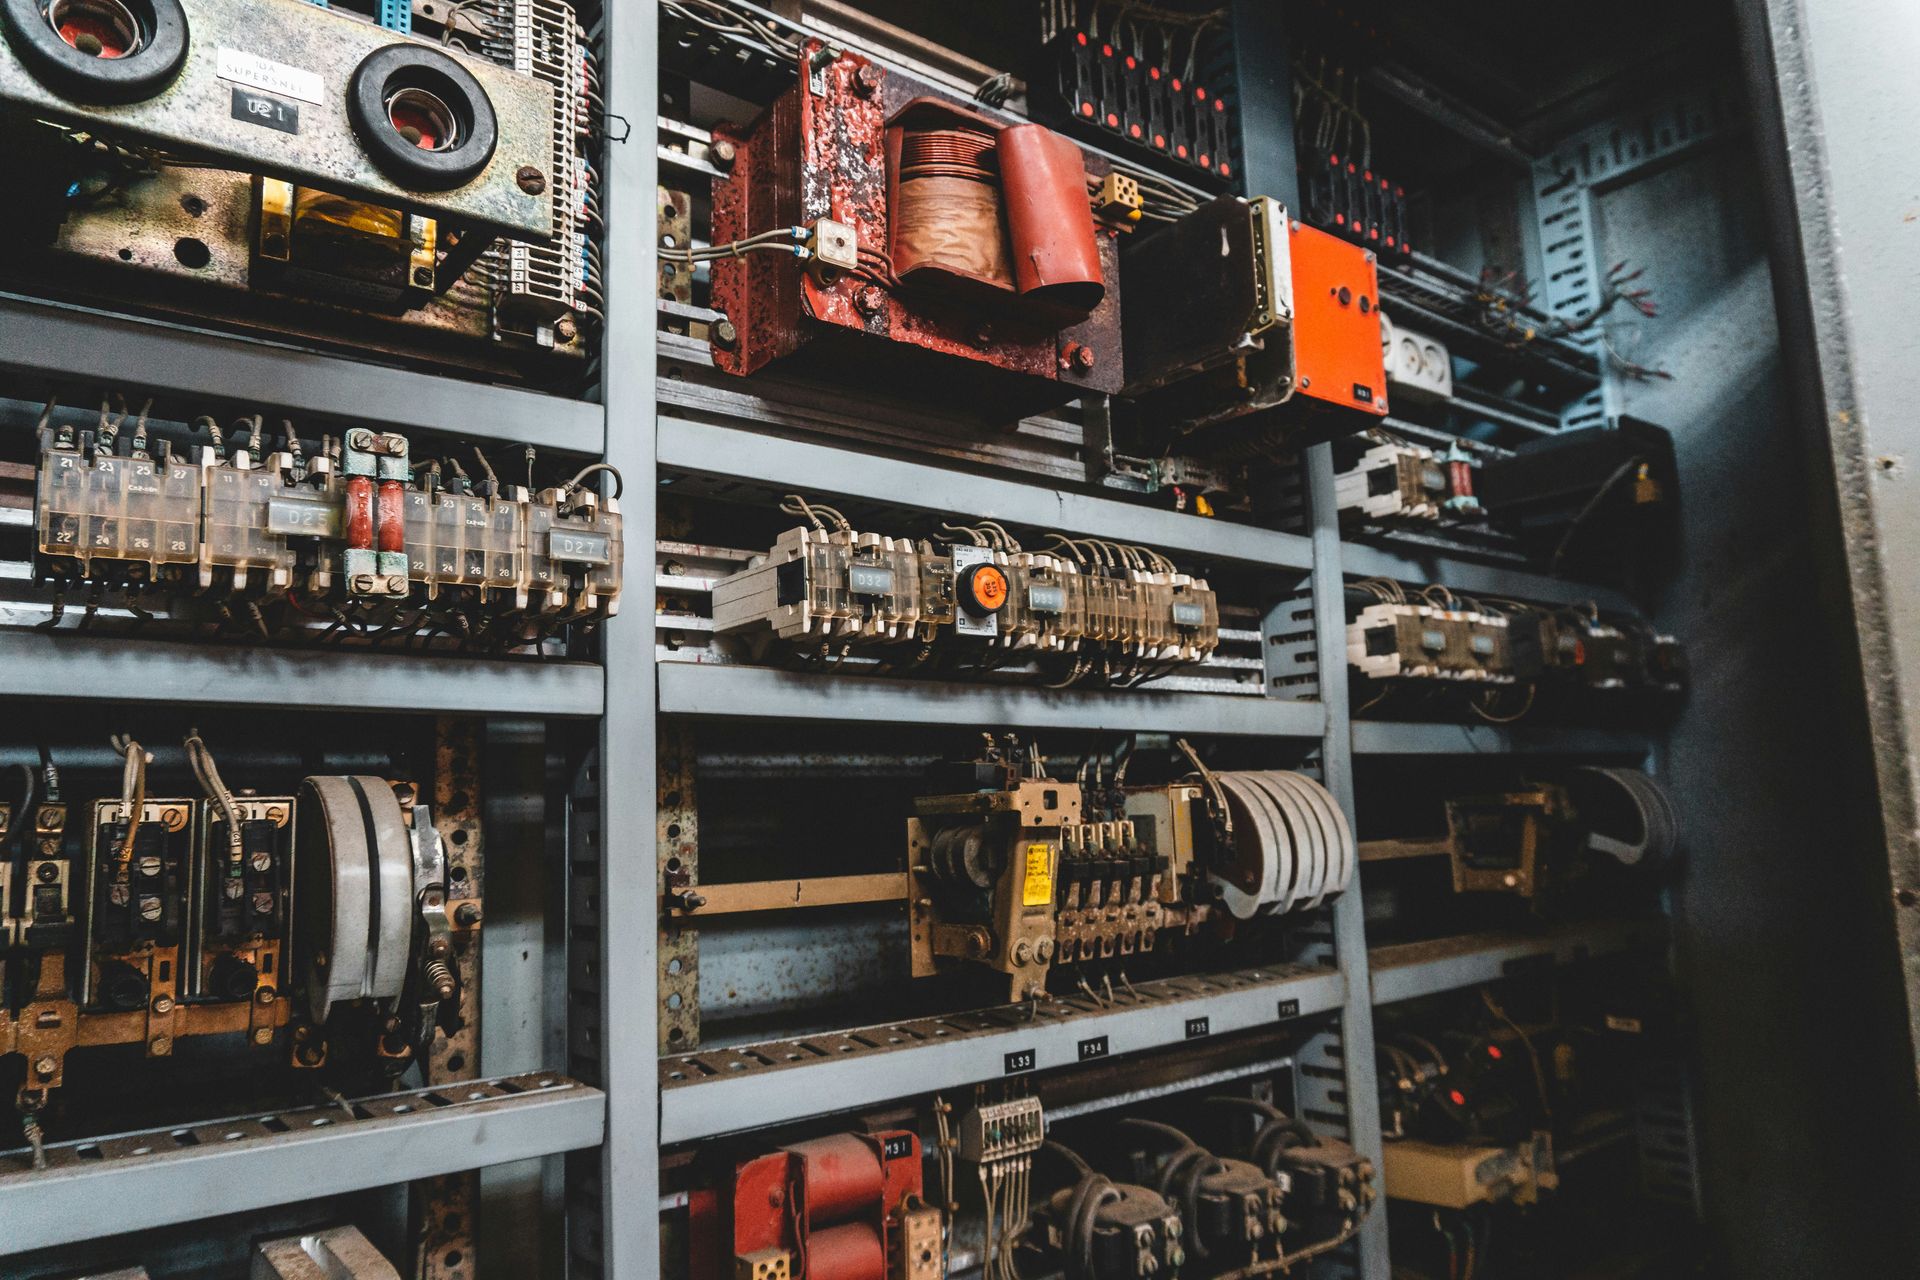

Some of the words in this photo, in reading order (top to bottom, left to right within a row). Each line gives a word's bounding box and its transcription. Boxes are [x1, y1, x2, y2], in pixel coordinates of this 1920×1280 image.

[577, 302, 585, 310] 27
[61, 457, 73, 468] 21
[99, 462, 114, 472] 23
[136, 465, 151, 476] 25
[173, 469, 187, 479] 27
[223, 475, 232, 483] 11
[258, 478, 269, 487] 13
[414, 496, 424, 505] 21
[443, 500, 454, 508] 23
[471, 503, 482, 511] 25
[499, 506, 509, 514] 27
[288, 509, 328, 529] D25
[56, 532, 71, 543] 22
[95, 535, 110, 545] 24
[133, 538, 149, 548] 26
[171, 541, 186, 551] 28
[222, 544, 232, 553] 12
[565, 539, 595, 554] D27
[412, 561, 424, 570] 22
[442, 564, 453, 572] 24
[470, 566, 481, 575] 26
[499, 569, 510, 577] 28
[538, 571, 548, 579] 12
[858, 573, 882, 587] D32
[1083, 1042, 1103, 1055] F34
[1010, 1055, 1031, 1069] L33
